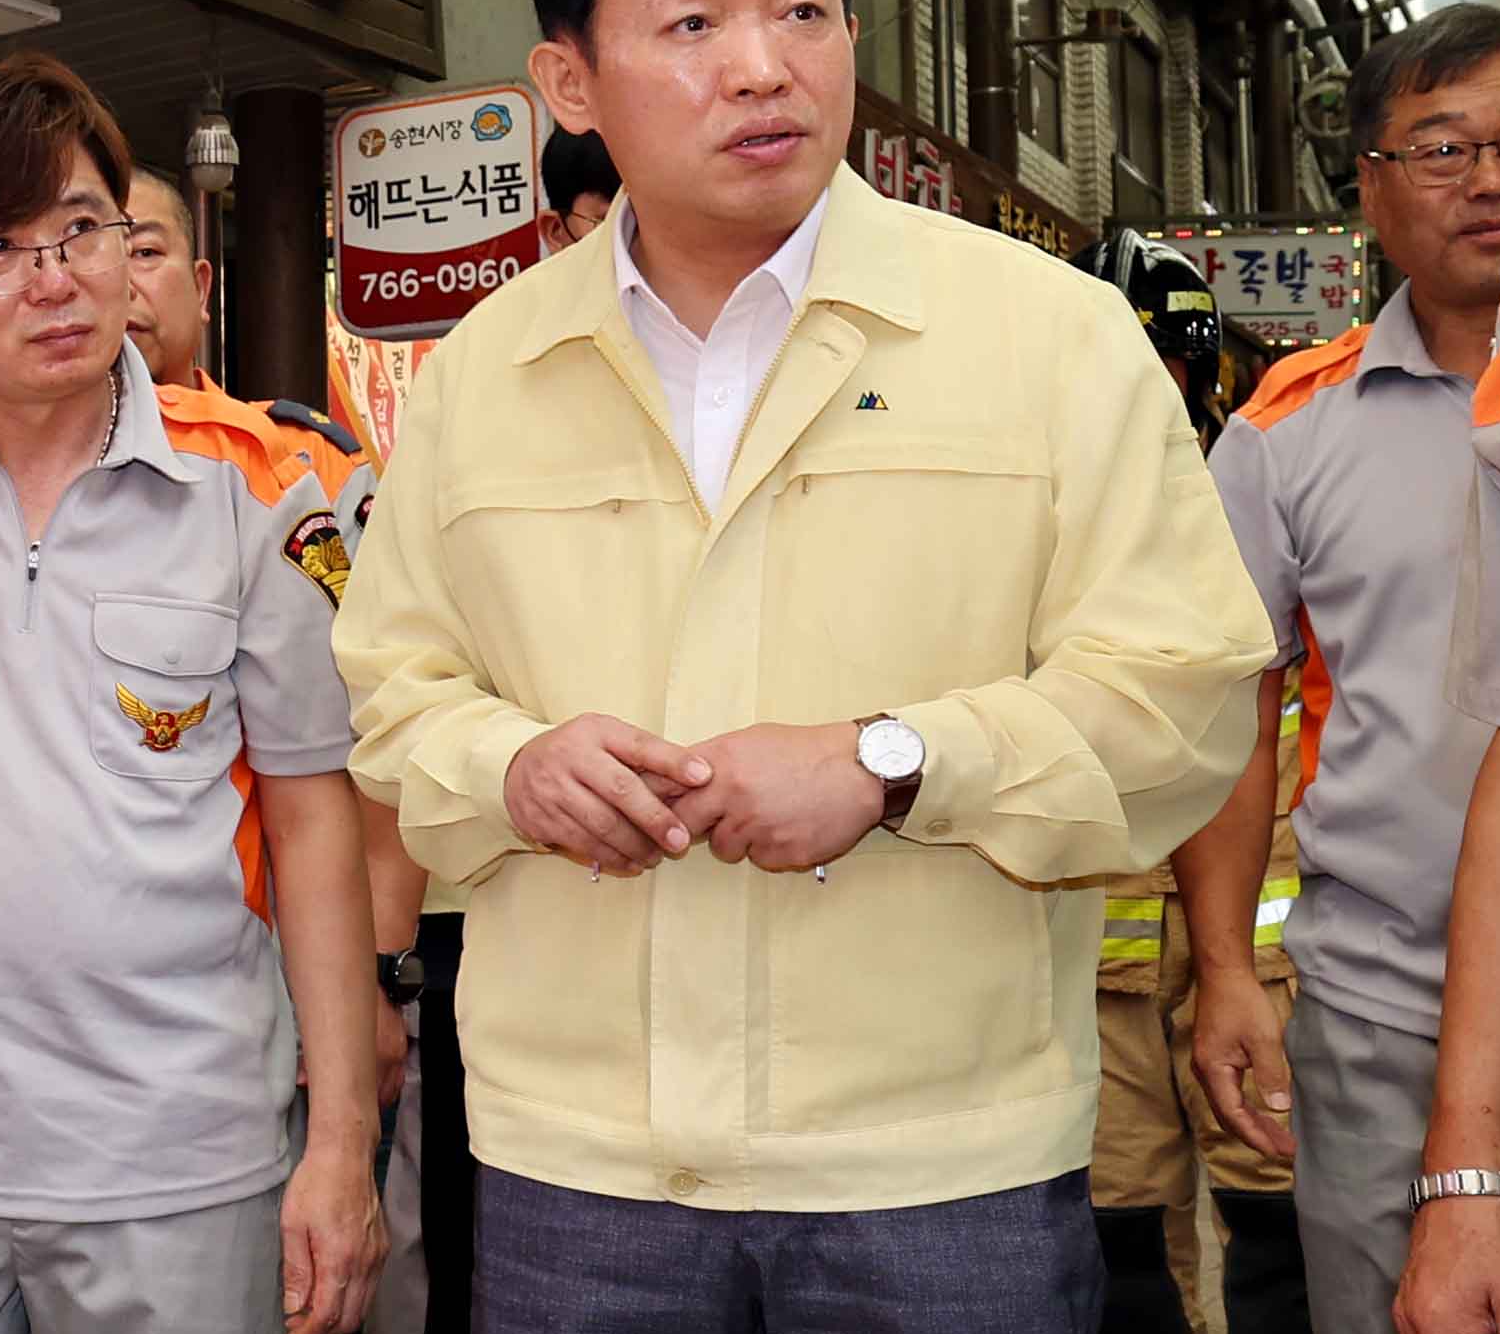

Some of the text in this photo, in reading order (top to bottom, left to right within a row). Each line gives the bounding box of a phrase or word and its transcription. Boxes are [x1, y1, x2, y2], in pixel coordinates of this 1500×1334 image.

[389, 119, 463, 150] 송현시장
[347, 162, 528, 229] 해뜨는식품
[358, 256, 520, 303] 766-0960
[1233, 247, 1315, 306] 족발
